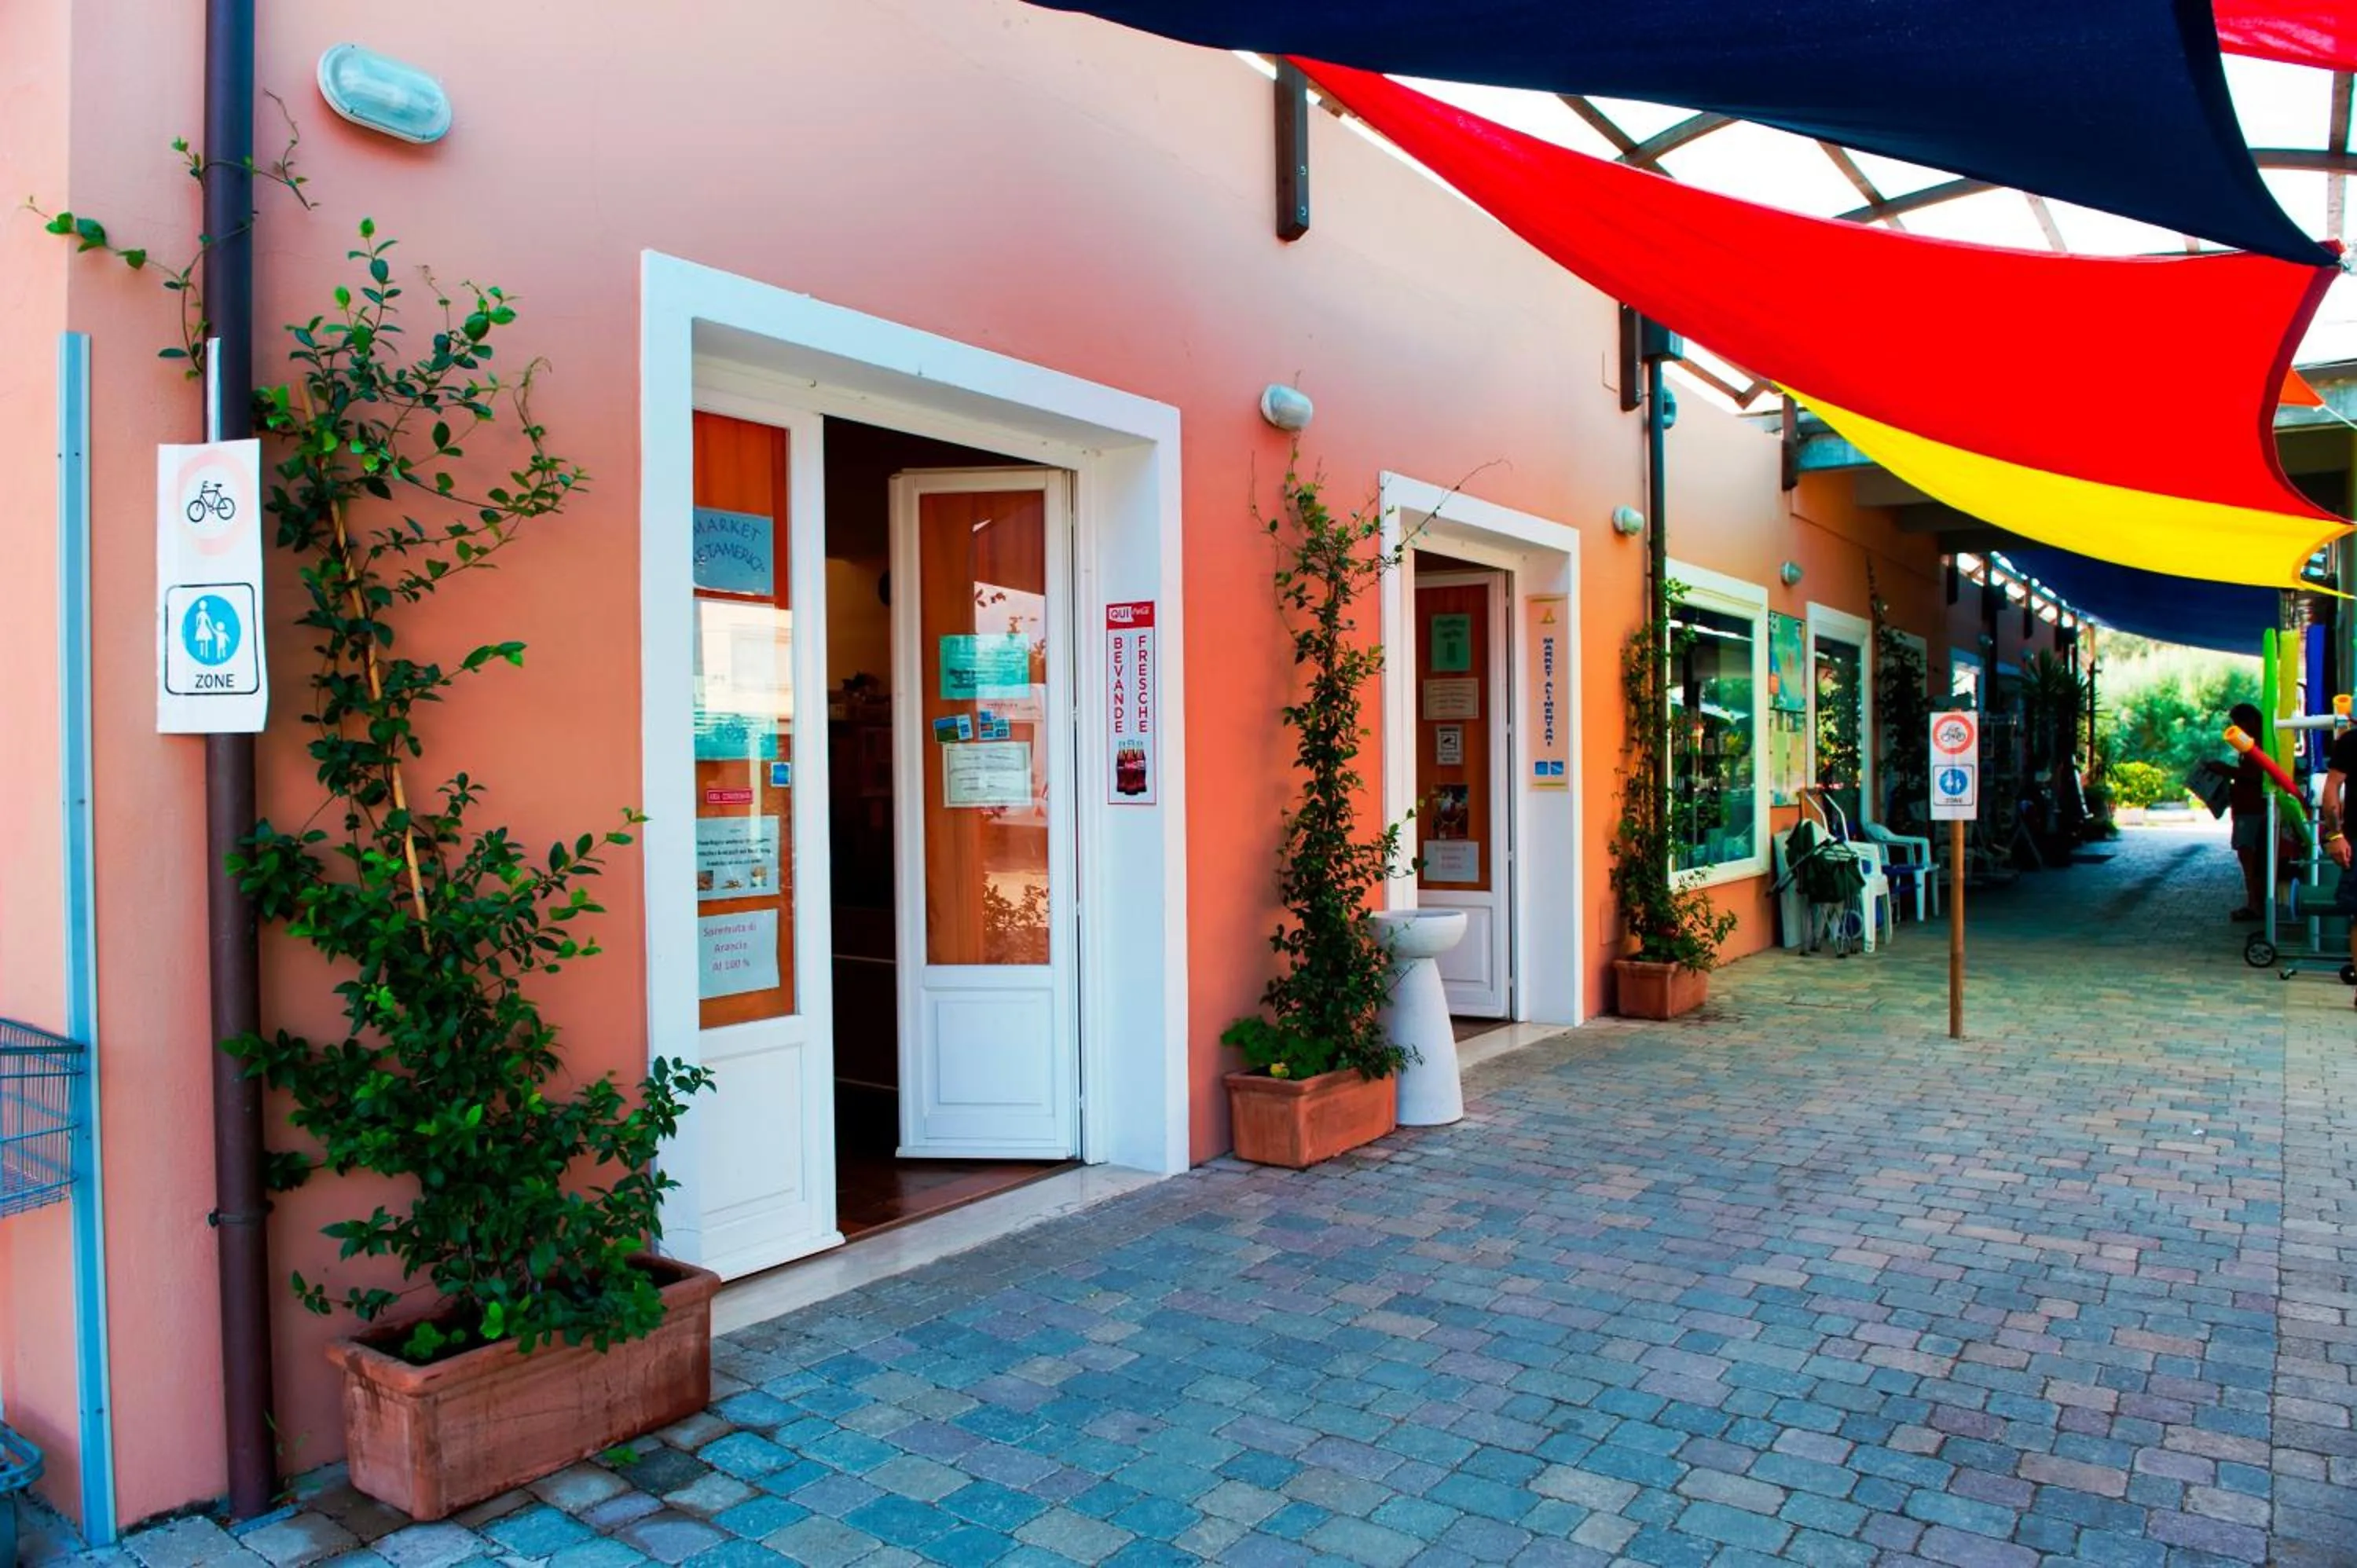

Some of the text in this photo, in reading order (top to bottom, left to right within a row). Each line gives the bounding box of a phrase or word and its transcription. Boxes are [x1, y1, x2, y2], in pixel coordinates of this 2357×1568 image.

[1111, 608, 1129, 619] QUI
[1543, 637, 1554, 676] MARKET
[195, 673, 234, 689] ZONE
[1113, 637, 1124, 733] BEVANDE
[1138, 635, 1148, 733] FRESCHE
